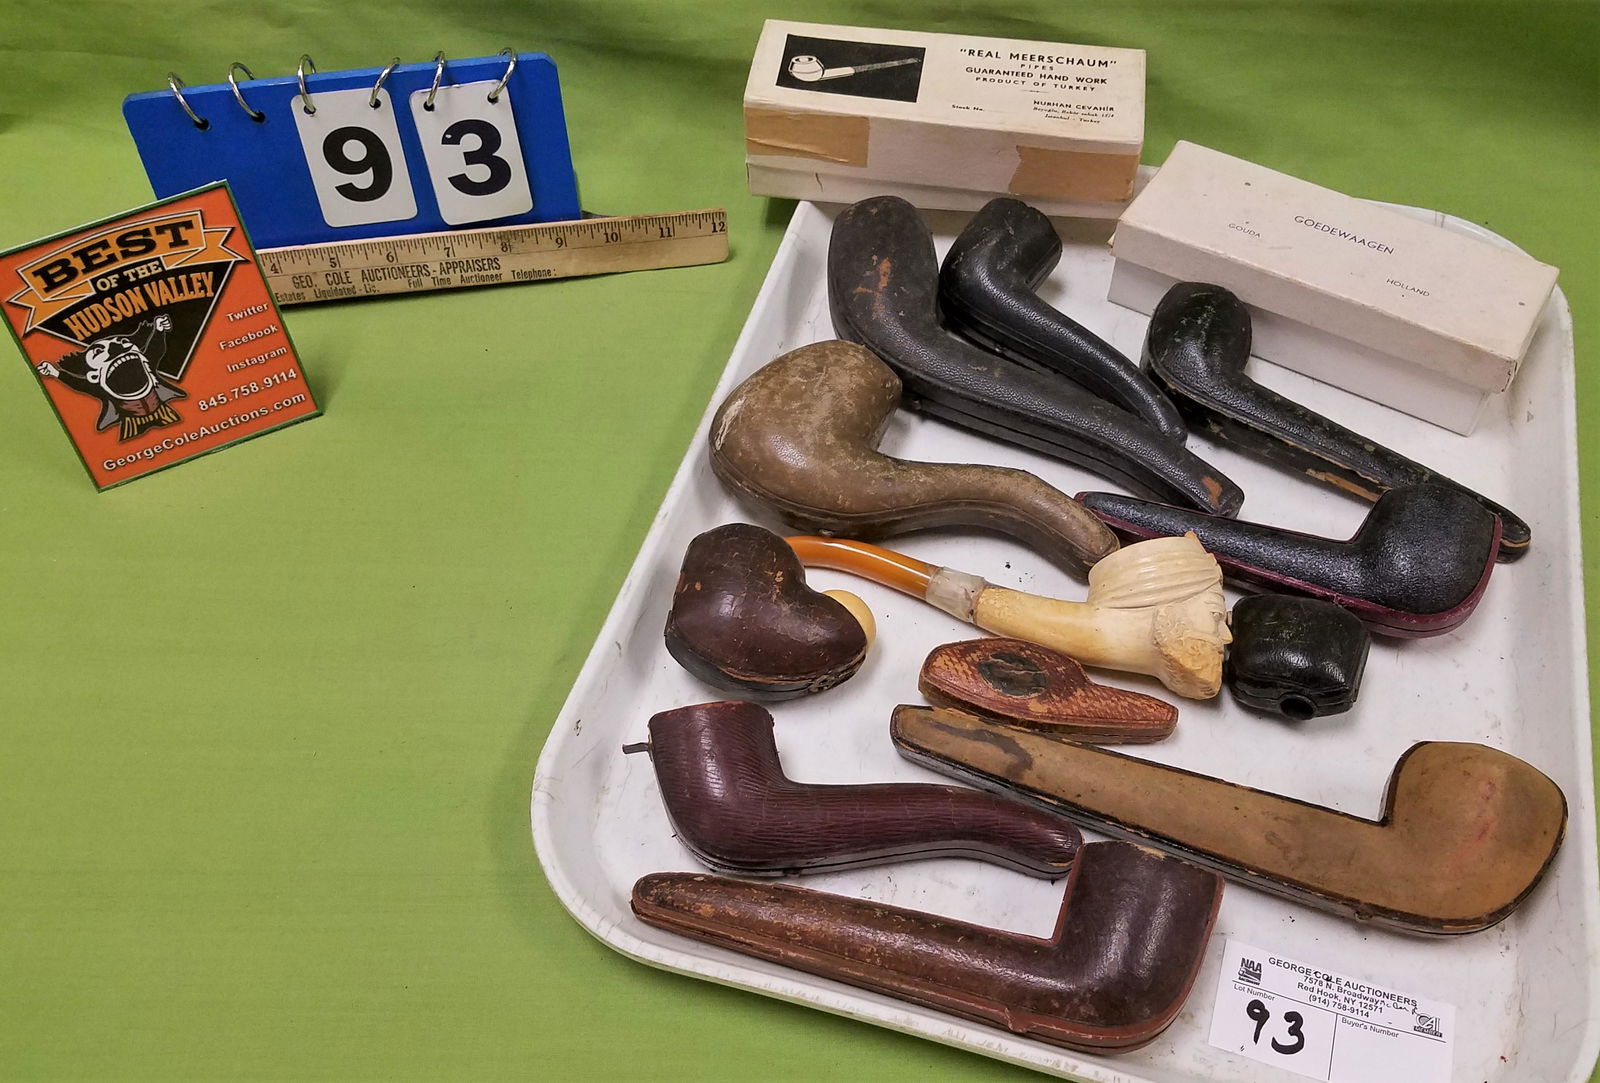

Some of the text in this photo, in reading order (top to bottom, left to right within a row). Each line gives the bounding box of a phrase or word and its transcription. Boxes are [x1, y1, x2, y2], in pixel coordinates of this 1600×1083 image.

[960, 48, 1118, 68] "REAL MEERSCHAUM"
[966, 66, 1108, 84] GUARANTEED HAND WORK
[976, 76, 1026, 86] PRODUCT
[1054, 84, 1096, 92] TURKEY
[1228, 223, 1261, 238] GOUDA
[1294, 215, 1394, 254] GOEDEWAAGEN
[32, 220, 194, 293] BEST
[270, 222, 726, 274] 4 5 6 7 8 9 10 11 12
[96, 260, 162, 292] OF THE
[275, 290, 306, 302] Estates
[314, 284, 356, 299] Liquidated
[408, 278, 423, 289] Full
[431, 276, 452, 288] Time
[460, 272, 503, 284] Auctioneer
[292, 275, 317, 290] GEO.
[325, 270, 352, 286] COLE
[1386, 278, 1430, 297] HOLLAND
[63, 271, 214, 342] HUDSON VALLEY
[226, 302, 269, 322] Twitter
[219, 324, 278, 350] Facebook
[226, 346, 288, 373] Instagram
[198, 368, 297, 412] 845.758.9114
[103, 392, 306, 472] GeorgeColeAuctions.com
[1240, 958, 1262, 973] NAA
[1234, 984, 1276, 1001] Lot Number
[1268, 957, 1418, 1006] GEORGE COLE AUCTIONEERS
[1304, 976, 1380, 1006] 7578 N. Broadway
[1298, 982, 1314, 992] Red
[1316, 988, 1341, 1002] Hook,
[1344, 996, 1356, 1005] NY
[1359, 1001, 1382, 1013] 12571
[1308, 994, 1330, 1008] (914)
[1332, 1000, 1370, 1018] 758-9114
[1246, 999, 1305, 1055] 93
[1342, 1016, 1399, 1038] Buyer's Number
